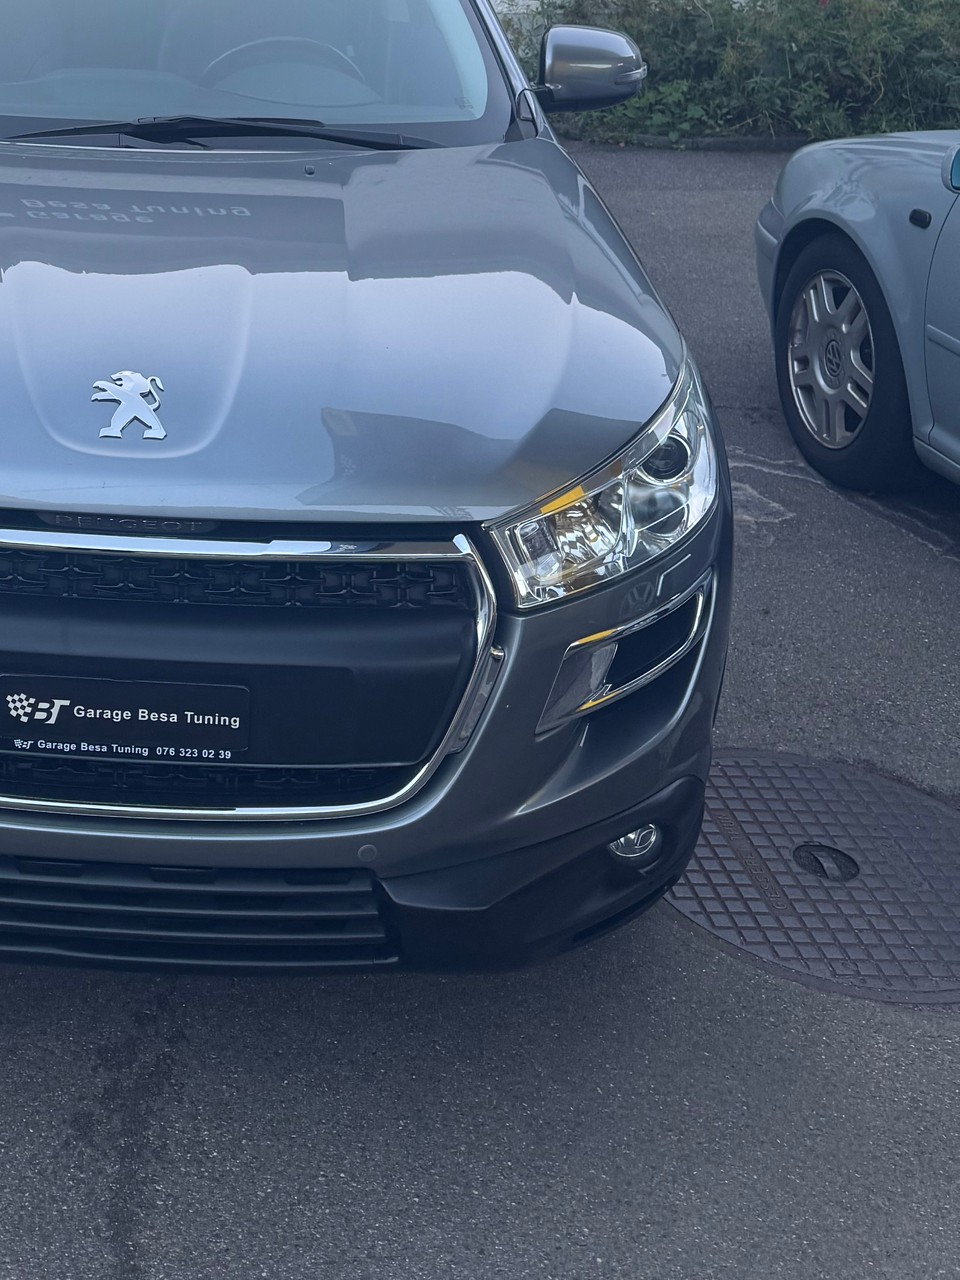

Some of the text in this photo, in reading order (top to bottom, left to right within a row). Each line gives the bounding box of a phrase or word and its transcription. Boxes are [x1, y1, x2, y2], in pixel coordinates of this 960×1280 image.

[73, 705, 132, 722] Garage
[138, 708, 178, 723] Besa
[184, 711, 240, 729] Tuning
[37, 739, 77, 752] Garage
[80, 742, 108, 753] Besa
[111, 744, 149, 756] Tuning
[156, 746, 176, 756] 076
[179, 748, 199, 757] 323
[202, 749, 215, 759] 02
[218, 750, 232, 760] 39
